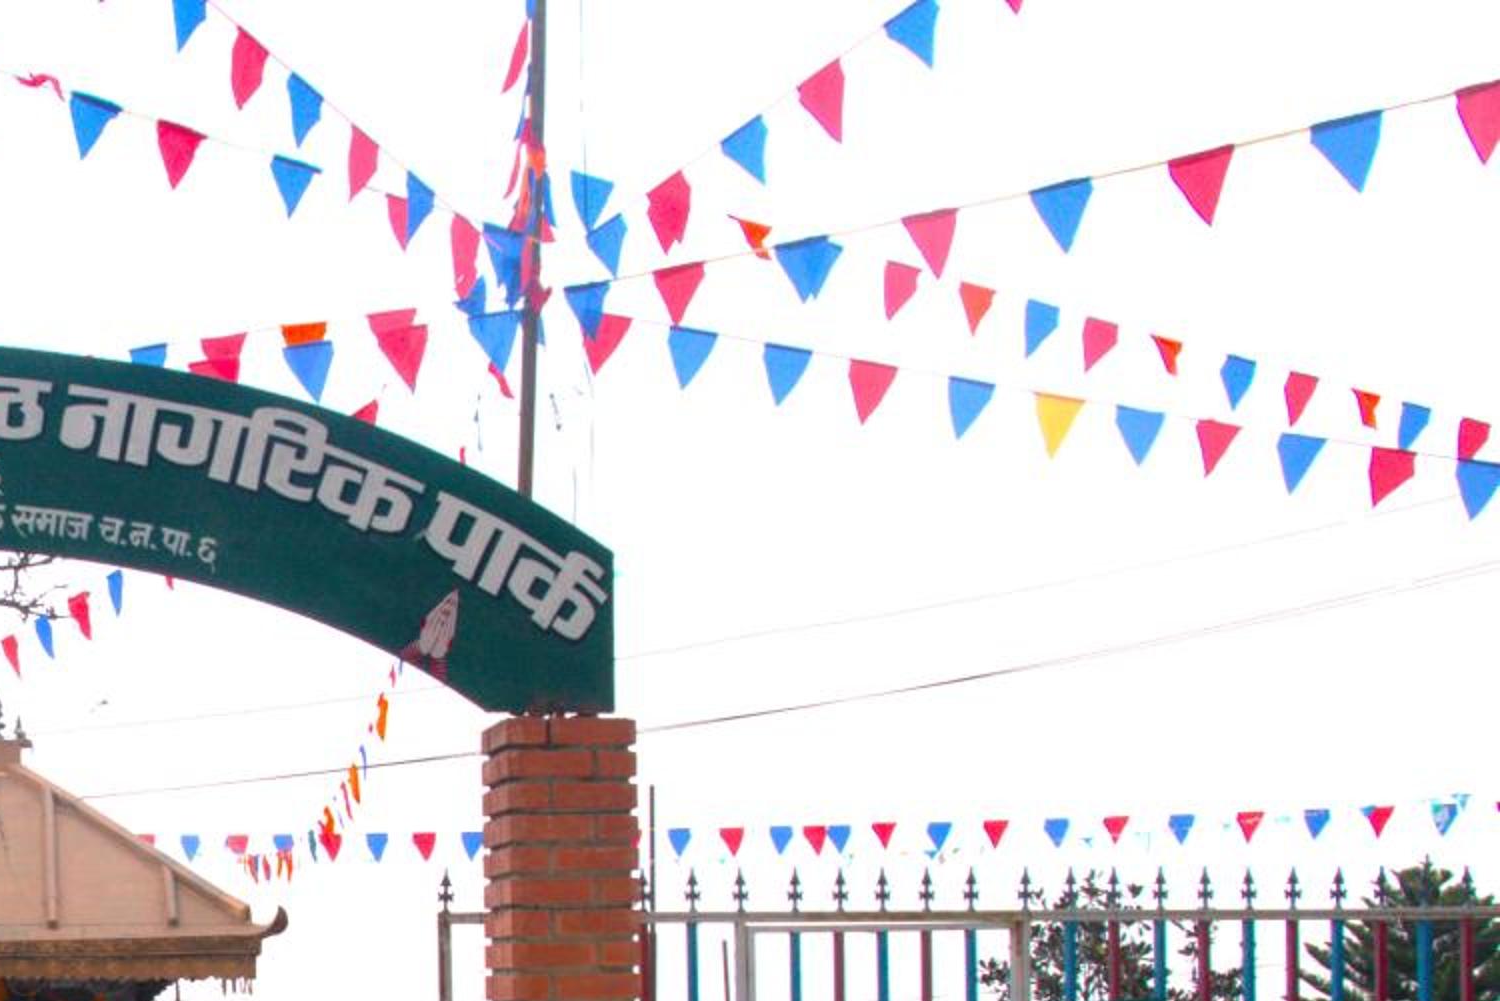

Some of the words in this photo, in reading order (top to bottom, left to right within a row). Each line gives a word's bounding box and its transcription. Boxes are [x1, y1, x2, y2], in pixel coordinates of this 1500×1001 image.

[11, 504, 93, 541] समाज
[60, 384, 426, 534] नागरिक
[425, 490, 609, 641] पार्क
